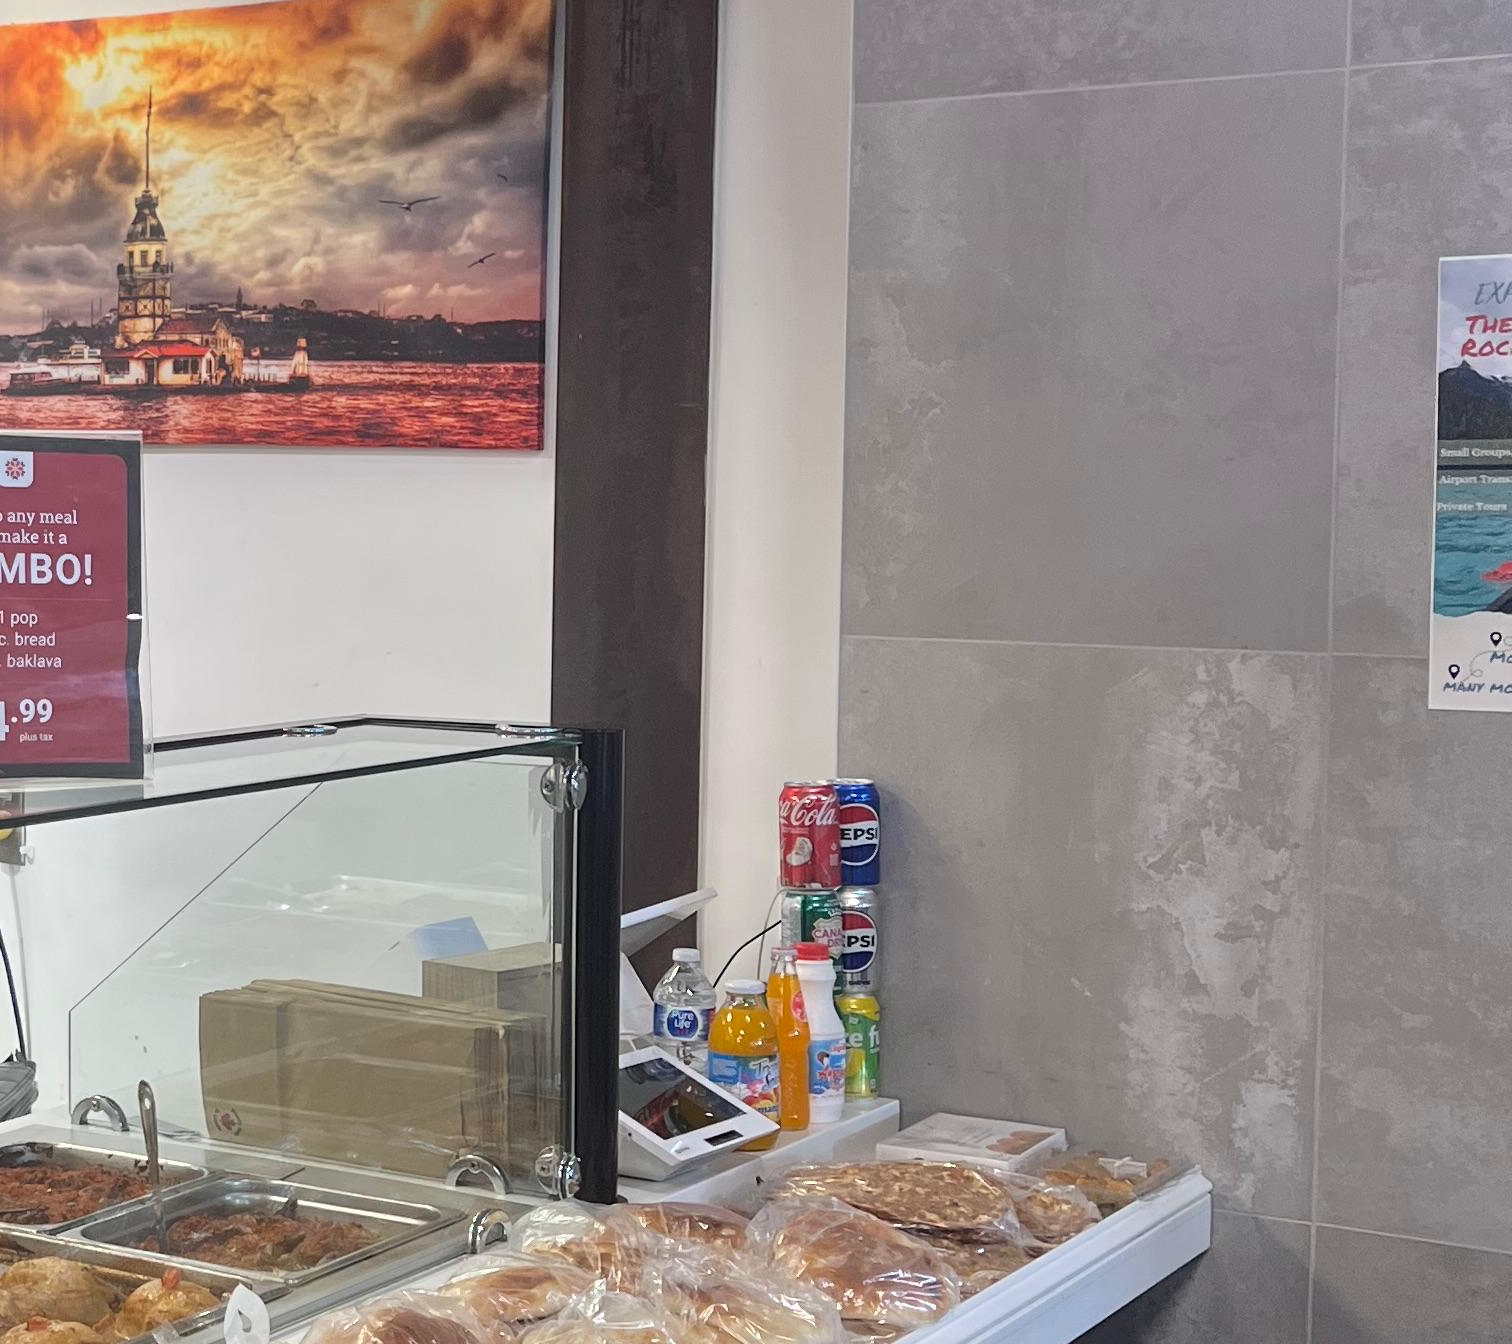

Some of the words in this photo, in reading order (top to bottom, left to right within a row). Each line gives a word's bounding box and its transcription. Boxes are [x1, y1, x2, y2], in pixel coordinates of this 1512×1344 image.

[1465, 315, 1512, 335] THE
[1461, 338, 1512, 358] ROC
[1440, 448, 1470, 457] Small
[1439, 475, 1477, 486] Airport
[1437, 502, 1474, 511] Private
[1475, 502, 1508, 511] Tours
[7, 512, 36, 528] any
[40, 509, 78, 525] meal
[43, 531, 55, 545] it
[58, 534, 68, 545] a
[10, 613, 38, 629] pop
[15, 632, 56, 647] bread
[6, 654, 62, 669] baklava
[1443, 682, 1486, 694] MANY
[19, 732, 38, 744] plus
[40, 733, 54, 742] tax
[670, 1009, 694, 1022] Pure
[674, 1018, 692, 1030] Life
